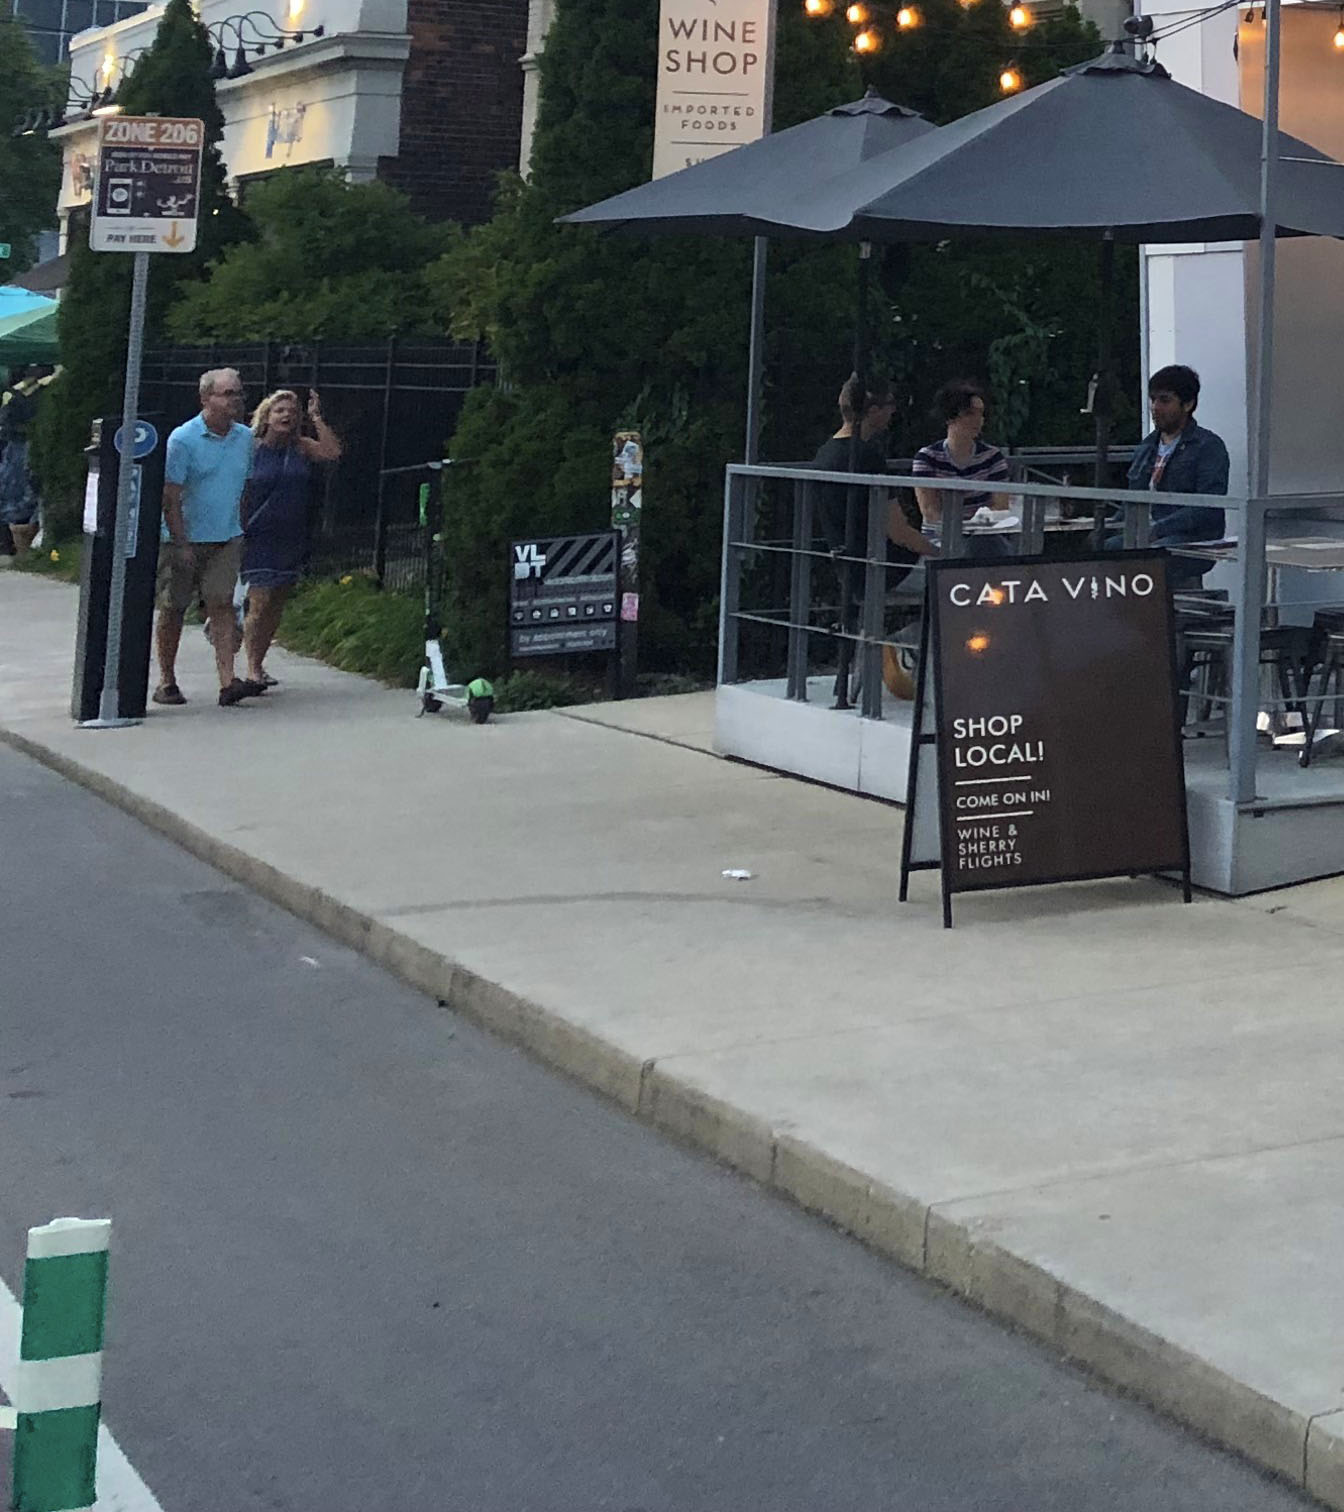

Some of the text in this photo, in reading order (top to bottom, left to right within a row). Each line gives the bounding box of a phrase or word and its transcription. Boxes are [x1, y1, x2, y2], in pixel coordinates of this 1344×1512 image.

[668, 17, 757, 44] WINE
[665, 49, 758, 75] SHOP
[663, 104, 755, 117] IMPORTED
[105, 121, 198, 144] ZONE 206
[680, 119, 737, 131] FOODS
[105, 234, 157, 244] PAY HERE
[950, 573, 1154, 607] CATA VINO
[953, 714, 1023, 739] SHOP
[954, 740, 1045, 768] LOCAL!
[956, 789, 1051, 809] COME ON IN!
[957, 824, 1018, 840] WINE &
[958, 838, 1017, 856] SHERRY
[958, 852, 1022, 870] FLIGHTS
